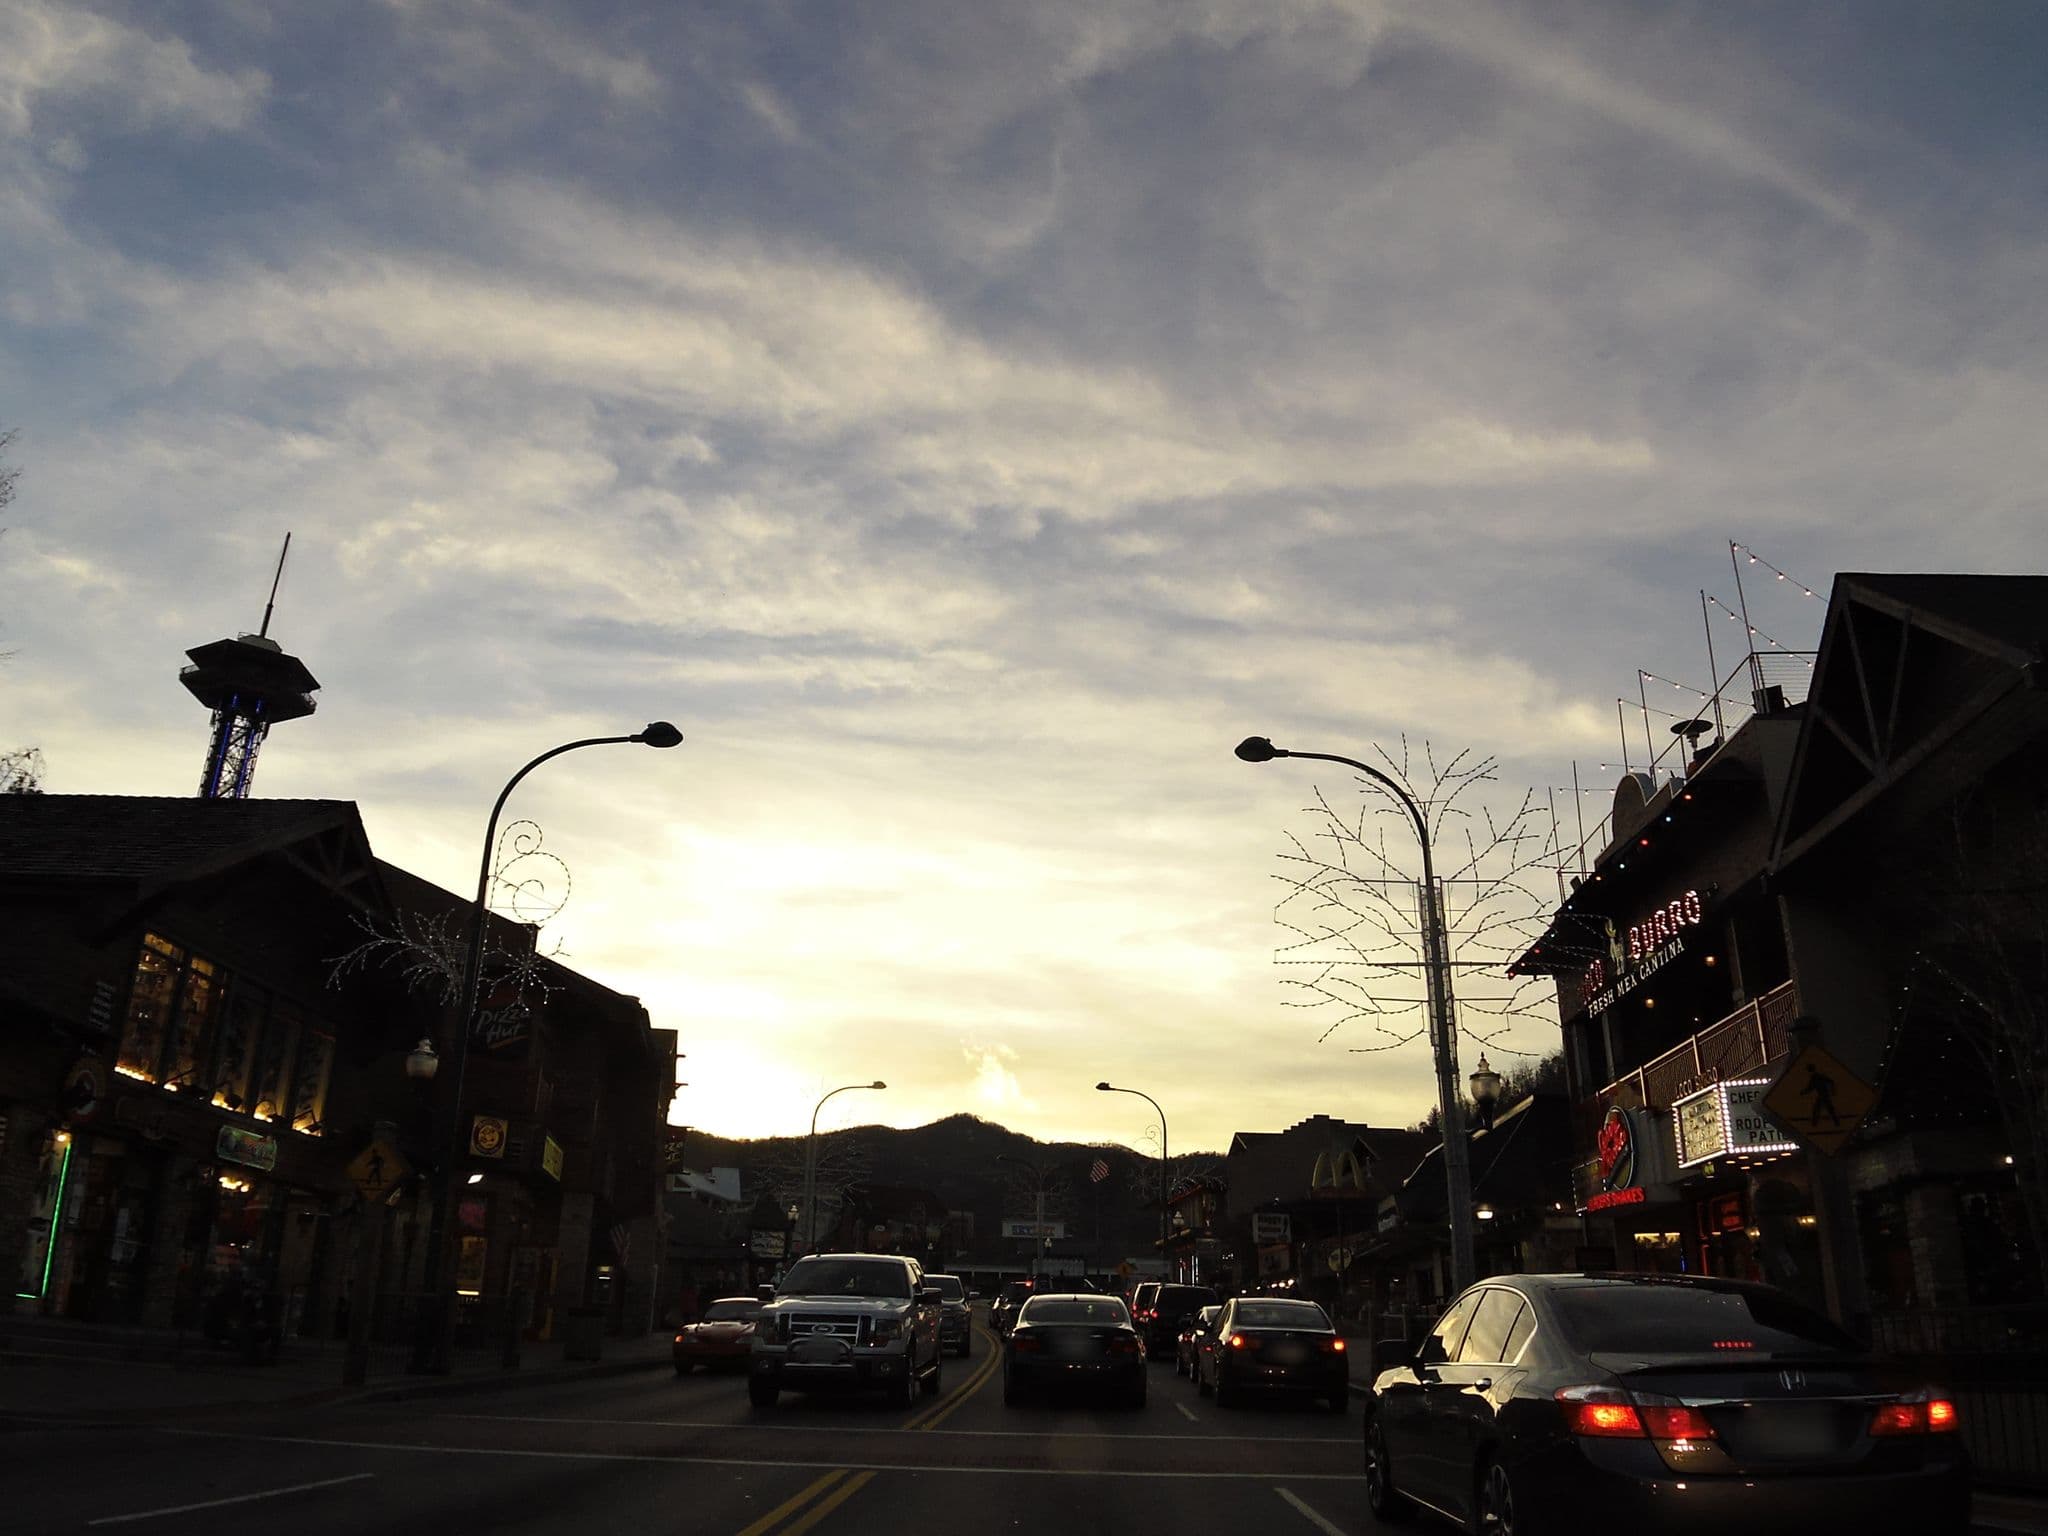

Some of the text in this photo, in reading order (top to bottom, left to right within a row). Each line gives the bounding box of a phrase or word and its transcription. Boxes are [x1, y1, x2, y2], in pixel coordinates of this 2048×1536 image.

[1628, 889, 1701, 959] BURRO
[1587, 937, 1686, 1019] FRESH MEX CANTINA
